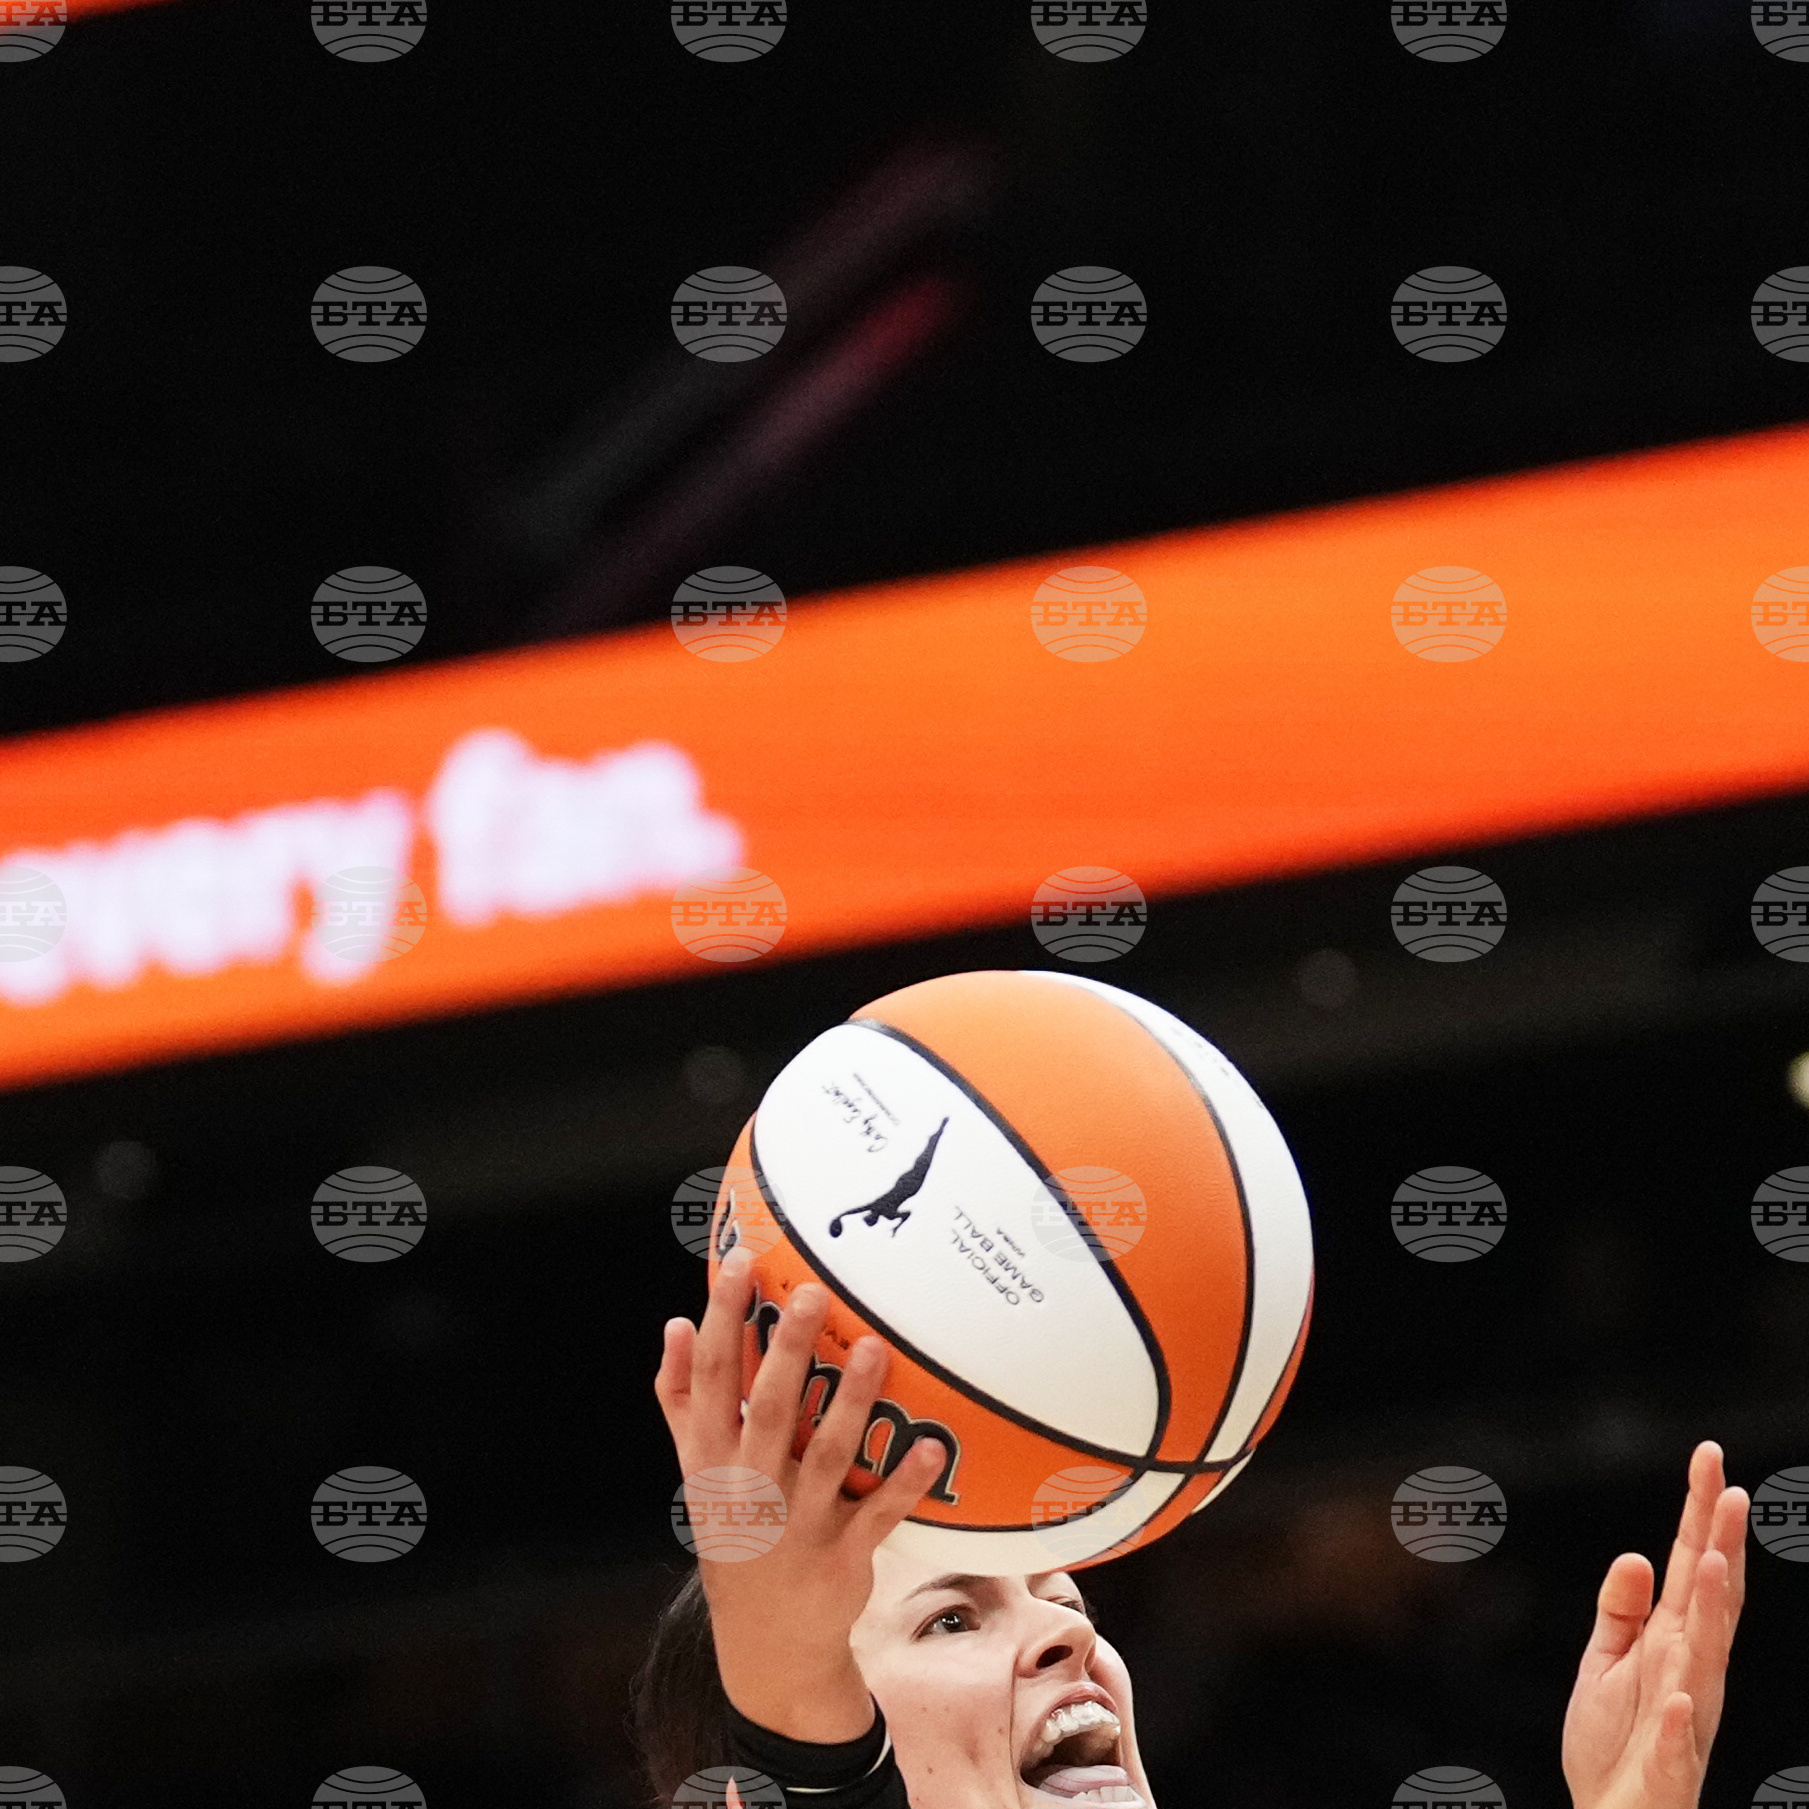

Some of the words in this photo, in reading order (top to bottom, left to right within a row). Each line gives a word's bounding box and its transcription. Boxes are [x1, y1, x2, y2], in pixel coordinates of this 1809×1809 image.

[953, 1205, 995, 1253] BALL
[950, 1228, 1020, 1305] OFFICIAL
[993, 1251, 1045, 1303] GAME
